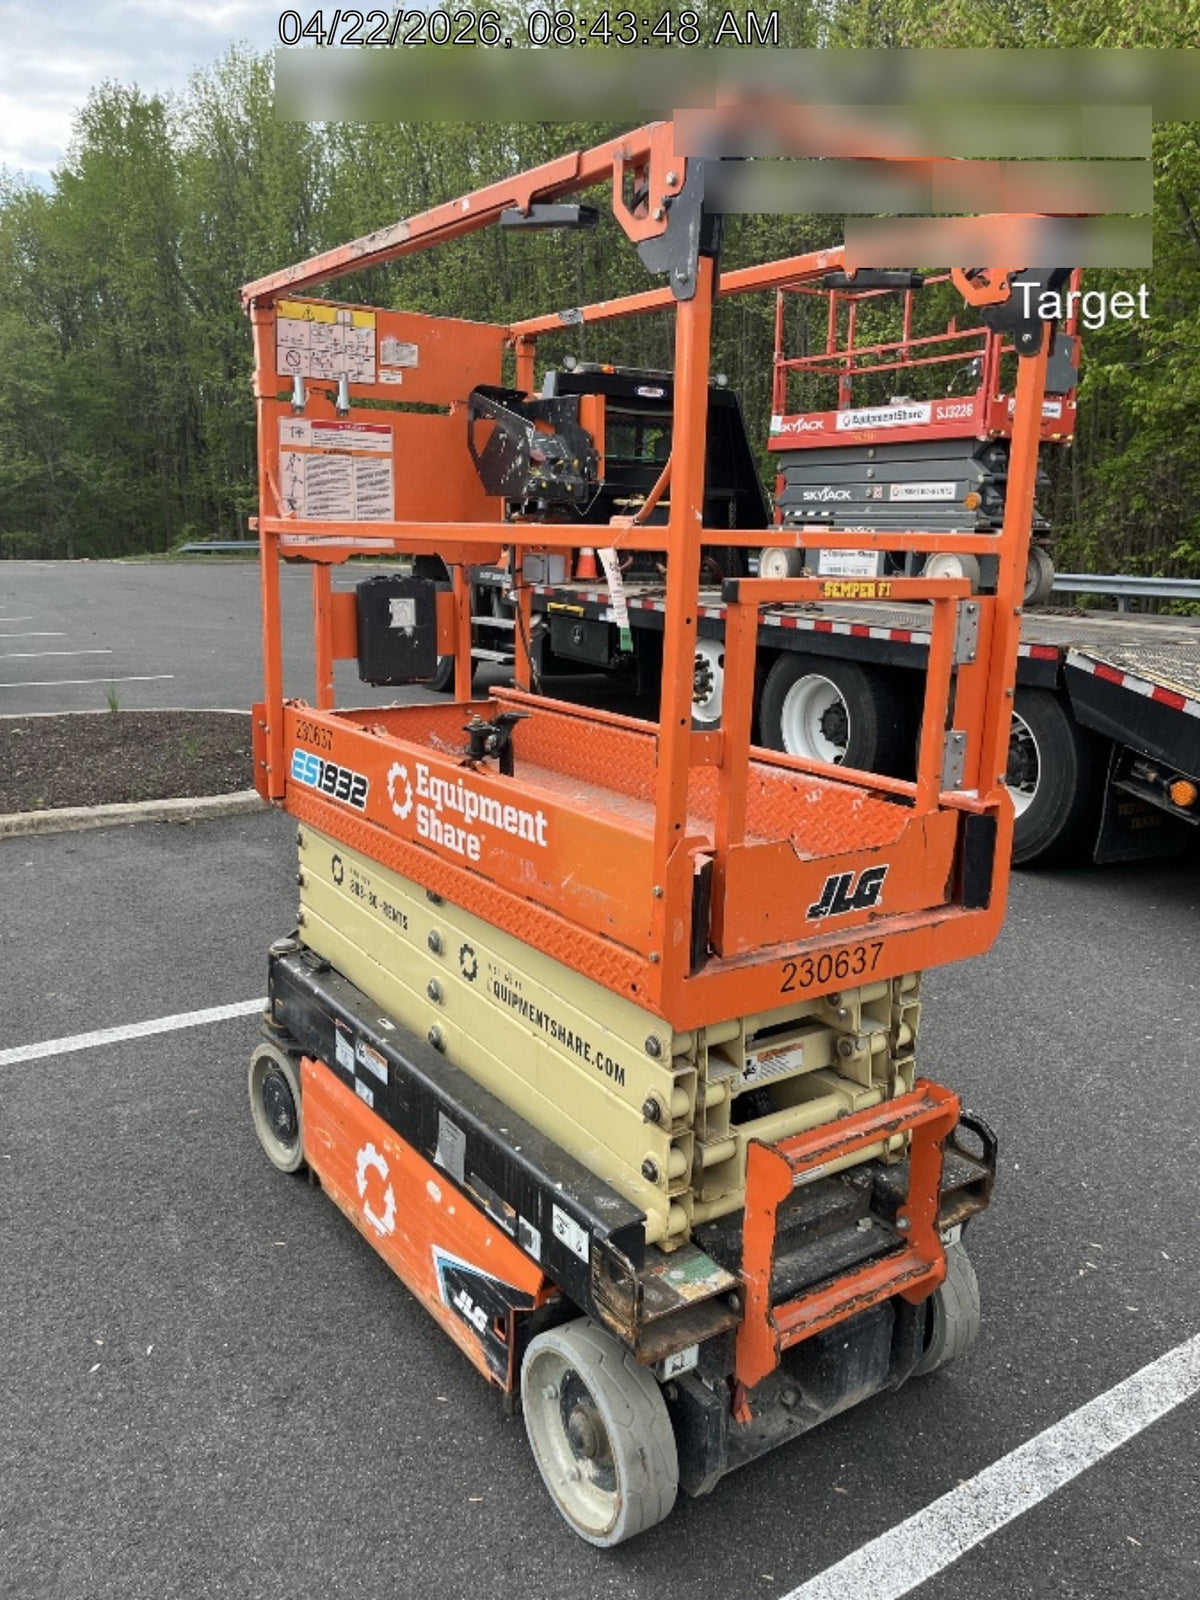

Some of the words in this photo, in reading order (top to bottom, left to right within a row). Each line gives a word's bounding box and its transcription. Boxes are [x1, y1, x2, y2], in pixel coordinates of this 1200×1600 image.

[936, 402, 974, 420] SJ3226
[803, 485, 851, 502] SKYJACK
[824, 582, 876, 598] SEMPER
[878, 582, 891, 597] FI
[296, 719, 333, 751] 230637
[291, 749, 369, 811] ES1932
[415, 762, 548, 847] Equipment
[805, 864, 890, 922] JLG
[780, 942, 884, 993] 230637
